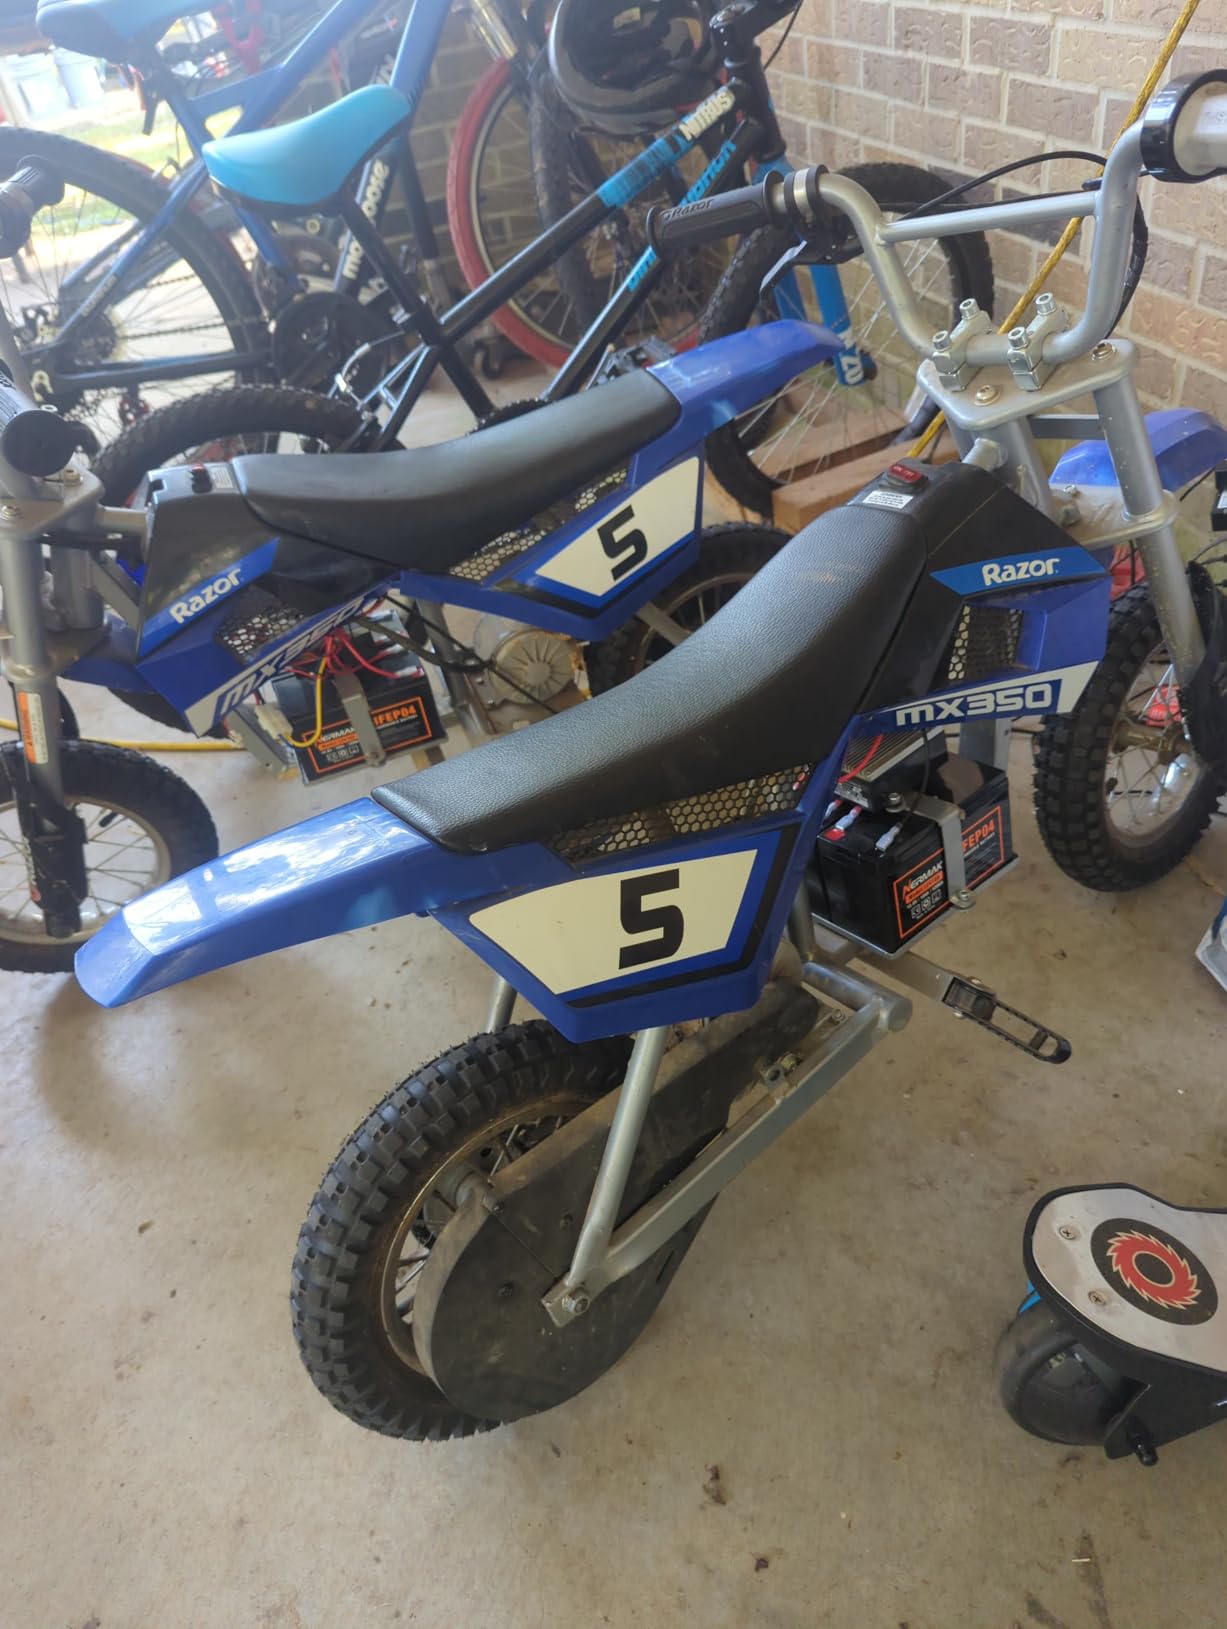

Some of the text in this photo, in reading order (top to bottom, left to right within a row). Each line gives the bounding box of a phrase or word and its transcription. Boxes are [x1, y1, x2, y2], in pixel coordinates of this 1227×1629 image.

[343, 160, 389, 280] mooose
[597, 504, 648, 581] 5
[982, 558, 1060, 586] Razor
[170, 568, 241, 624] Razor
[618, 868, 684, 970] 5
